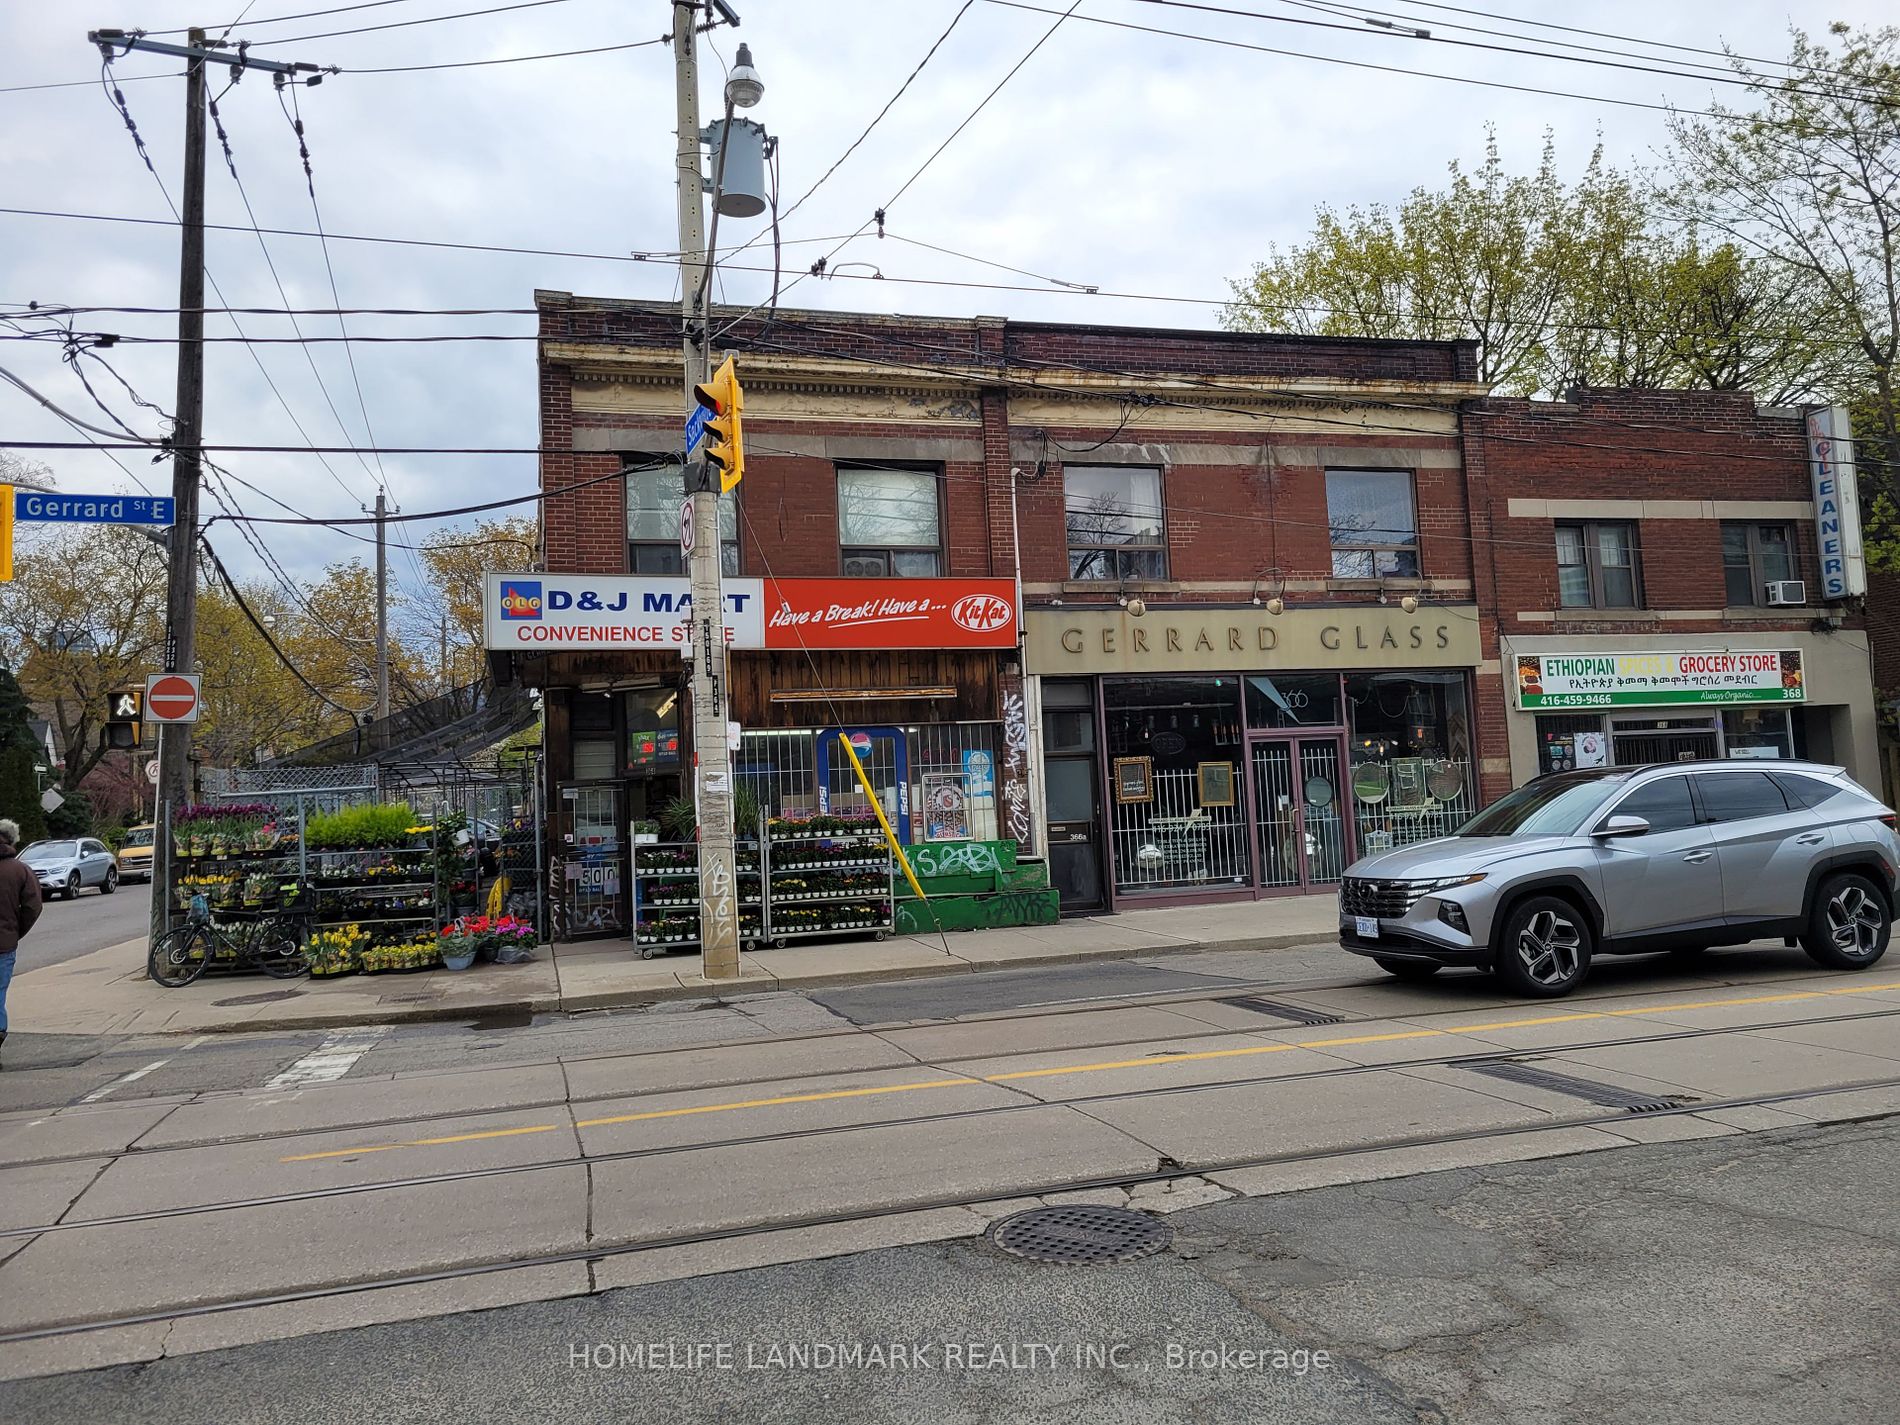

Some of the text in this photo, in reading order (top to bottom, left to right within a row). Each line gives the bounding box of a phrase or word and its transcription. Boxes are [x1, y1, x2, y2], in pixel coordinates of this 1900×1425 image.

[26, 497, 165, 519] Gerrard St E
[1815, 441, 1843, 594] CLEANERS
[503, 596, 540, 610] OLG
[547, 590, 751, 613] D&J MAT
[768, 609, 810, 628] Have
[811, 612, 824, 623] a
[825, 600, 879, 623] Break!
[879, 598, 918, 616] Have
[517, 625, 735, 642] CONVENIENCE STE
[1061, 625, 1449, 654] GERRARD GLASS
[1546, 658, 1615, 677] ETHIOPIAN
[1679, 655, 1736, 674] GROCERY
[1739, 654, 1777, 672] STORE
[1540, 694, 1612, 706] 416-459-9466
[1700, 691, 1724, 702] Always
[1782, 688, 1802, 699] 368
[819, 785, 829, 814] EPSI
[900, 781, 909, 816] PEPSI
[1070, 833, 1087, 841] 366a
